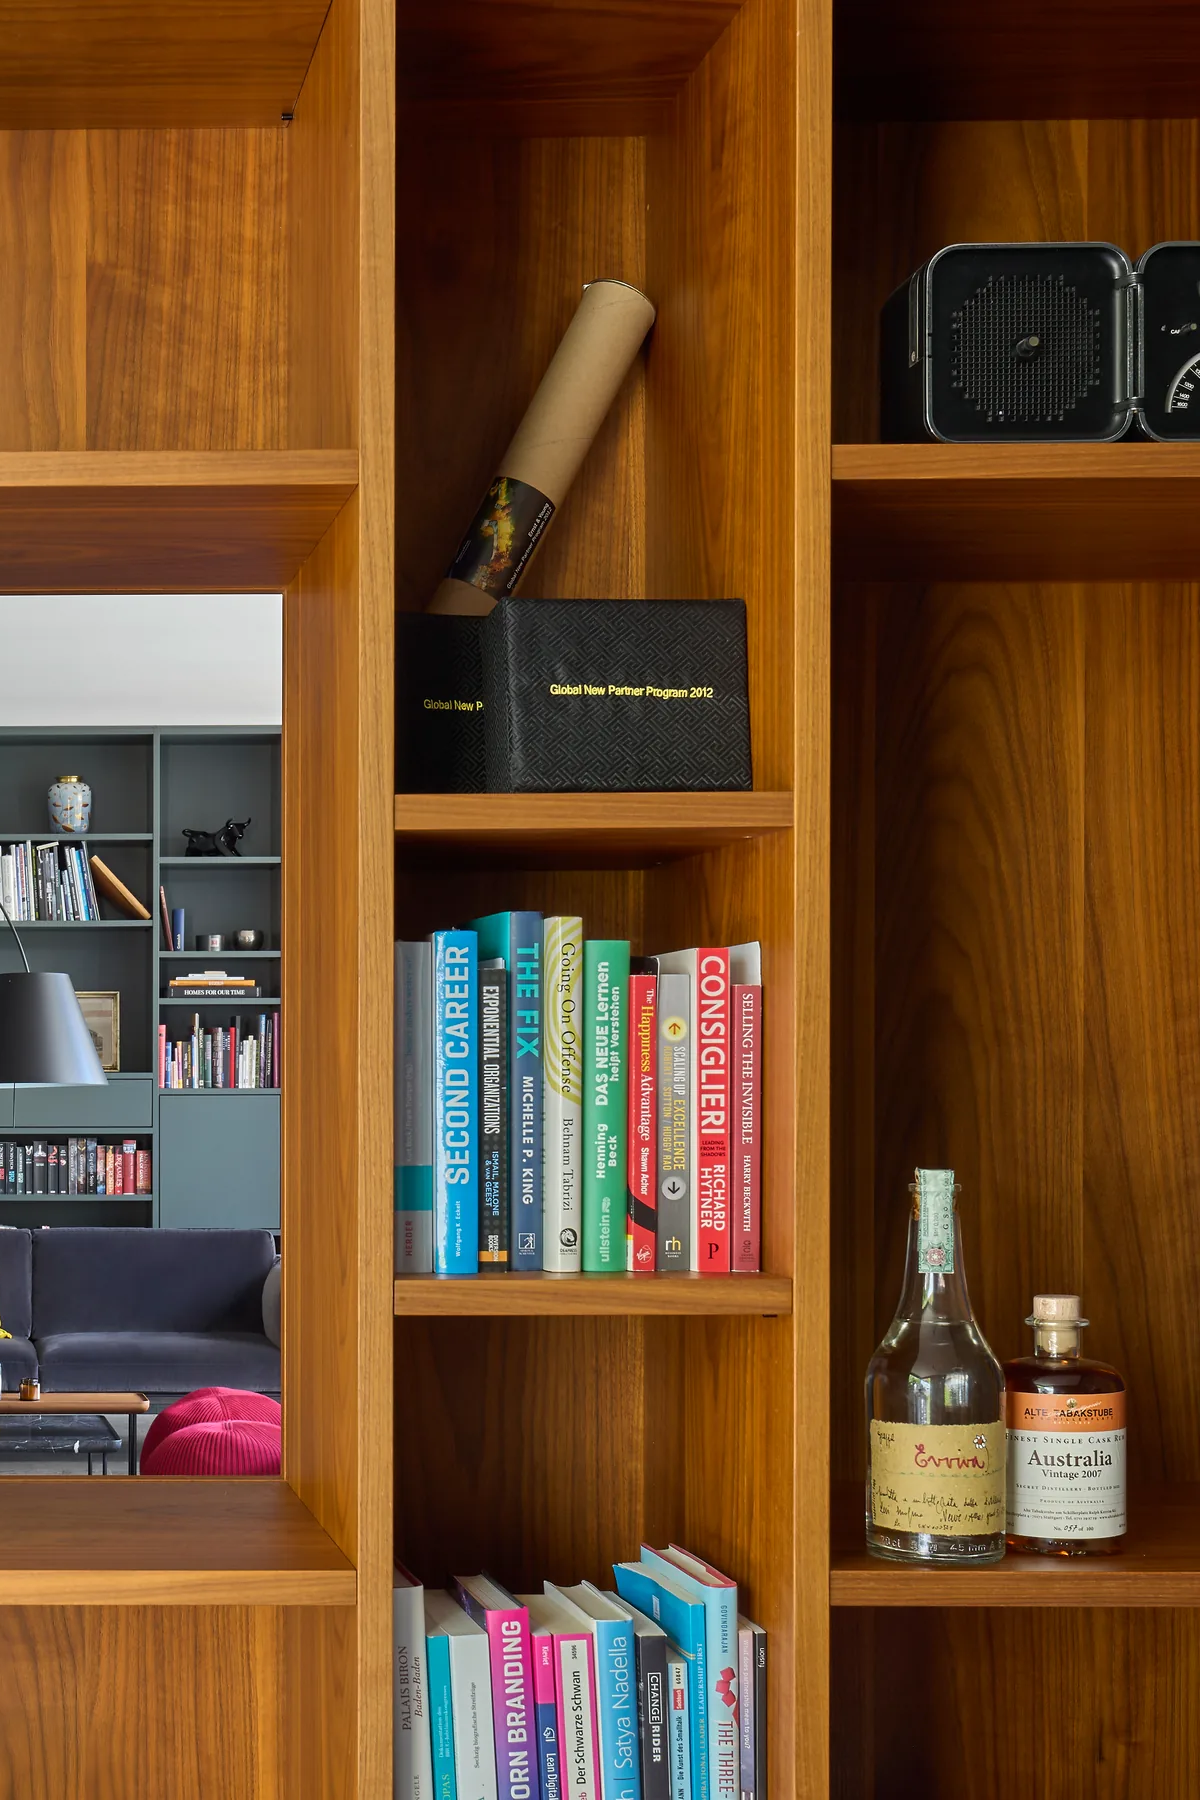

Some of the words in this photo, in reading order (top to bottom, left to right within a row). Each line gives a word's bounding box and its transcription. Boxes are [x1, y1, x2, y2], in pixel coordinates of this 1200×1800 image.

[506, 572, 518, 589] Global
[423, 699, 453, 710] Global
[454, 700, 474, 711] New
[549, 684, 582, 695] Global
[583, 684, 606, 696] New
[608, 685, 645, 697] Partner
[645, 686, 688, 700] Program
[689, 687, 714, 699] 2012
[516, 942, 539, 998] THE
[557, 942, 576, 993] Going
[445, 946, 470, 1059] CAREER
[595, 962, 609, 1021] Lernen
[646, 989, 655, 1004] The
[483, 986, 500, 1061] EXPONENTIAL
[561, 999, 575, 1025] On
[609, 987, 620, 1048] Verstehen
[741, 993, 754, 1049] SELLING
[516, 1010, 539, 1059] FIX
[595, 1025, 609, 1068] NEUE
[638, 1005, 654, 1072] Happiness
[700, 955, 726, 1134] CONSIGLIERI
[561, 1030, 576, 1093] Offense
[608, 1051, 621, 1082] heißt
[662, 1046, 673, 1080] ROBERT
[673, 1046, 686, 1082] SCALING
[741, 1051, 754, 1079] THE
[483, 1064, 500, 1134] ORGANIZATIONS
[595, 1073, 609, 1106] DAS
[663, 1086, 673, 1118] SUTTON
[673, 1084, 686, 1096] UP
[522, 1076, 534, 1146] MICHELLE
[638, 1074, 654, 1141] Advantage
[741, 1081, 754, 1145] INVISIBLE
[445, 1068, 470, 1185] SECOND
[562, 1118, 574, 1166] Behnam
[663, 1126, 673, 1153] HUGGY
[673, 1099, 686, 1171] EXCELLENCE
[491, 1150, 499, 1179] ISMAIL,
[522, 1149, 534, 1163] P.
[595, 1124, 609, 1179] Henning
[607, 1136, 617, 1167] Beck
[640, 1147, 650, 1173] Shawn
[663, 1154, 673, 1171] RAO
[522, 1168, 534, 1205] KING
[640, 1174, 650, 1196] Achor
[743, 1155, 752, 1184] HARRY
[484, 1181, 492, 1207] GEEST
[491, 1181, 499, 1216] MALONE
[562, 1169, 574, 1212] Tabrizi
[700, 1168, 713, 1228] HYTNER
[713, 1164, 726, 1231] RICHARD
[743, 1186, 752, 1232] BECKWITH
[405, 1220, 413, 1257] HERDER
[454, 1228, 463, 1258] Wolfgang
[599, 1215, 610, 1262] ullstein
[665, 1236, 681, 1251] rh
[707, 1243, 719, 1259] P
[1024, 1408, 1049, 1417] ALTE
[1053, 1407, 1113, 1418] TABAKSTUBE
[1005, 1433, 1038, 1443] FINEST
[1043, 1435, 1083, 1445] SINGLE
[1088, 1435, 1112, 1444] CASK
[1027, 1449, 1113, 1467] Australia
[1041, 1469, 1080, 1480] Vintage
[1081, 1469, 1102, 1479] 2007
[1063, 1524, 1078, 1533] 057
[720, 1605, 729, 1654] GOVINDARAJAN
[696, 1642, 704, 1665] FIRST
[742, 1639, 750, 1655] What
[742, 1656, 750, 1671] does
[757, 1647, 765, 1668] fusion
[397, 1645, 410, 1685] BIRON
[501, 1620, 527, 1743] BRANDING
[608, 1636, 630, 1709] Nadella
[411, 1656, 423, 1718] Baden-Baden
[469, 1681, 477, 1711] Streifzüge
[570, 1670, 583, 1712] Schwan
[697, 1665, 705, 1715] LEADERSHIP
[742, 1671, 750, 1708] partnership
[400, 1687, 412, 1731] PALAIS
[742, 1708, 750, 1725] mean
[471, 1711, 479, 1746] biografische
[573, 1714, 585, 1764] Schwarze
[613, 1717, 636, 1769] Satya
[651, 1725, 661, 1763] RIDER
[675, 1716, 684, 1742] Smalltalk
[718, 1721, 734, 1746] THE
[742, 1733, 750, 1749] you?
[473, 1746, 481, 1769] Sechzig
[545, 1753, 557, 1772] Lean
[676, 1742, 684, 1753] des
[676, 1753, 684, 1770] Kunst
[508, 1750, 530, 1800] ORN
[545, 1773, 560, 1800] Digital
[575, 1766, 587, 1785] Der
[676, 1770, 684, 1781] Die
[718, 1750, 734, 1799] THREE-
